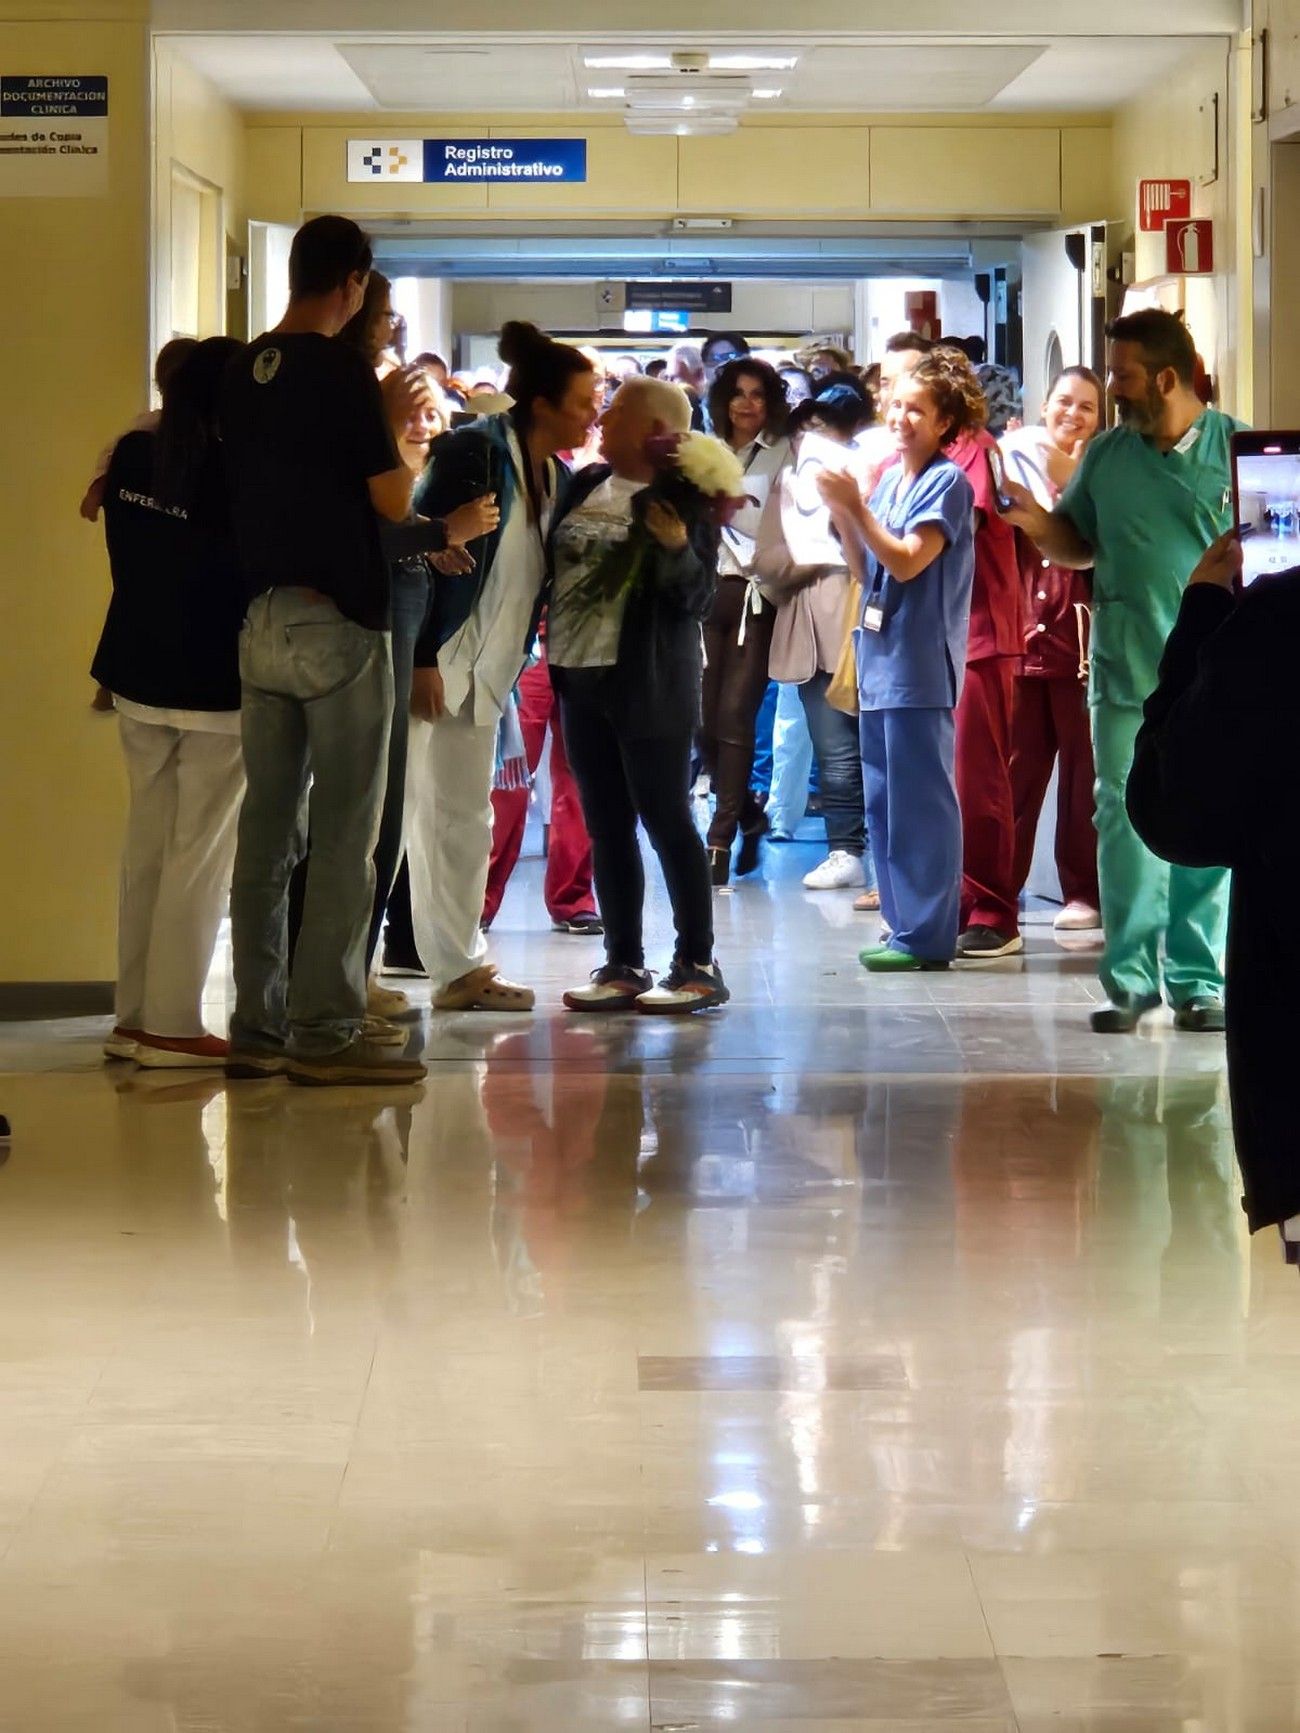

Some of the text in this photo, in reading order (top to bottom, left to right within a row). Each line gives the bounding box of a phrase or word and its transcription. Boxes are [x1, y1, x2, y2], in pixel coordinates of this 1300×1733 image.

[27, 79, 80, 88] ARCHIVO
[31, 105, 77, 114] CLINICA
[444, 145, 513, 162] Registro
[444, 162, 563, 177] Administrativo
[118, 488, 188, 520] ENFERRA
